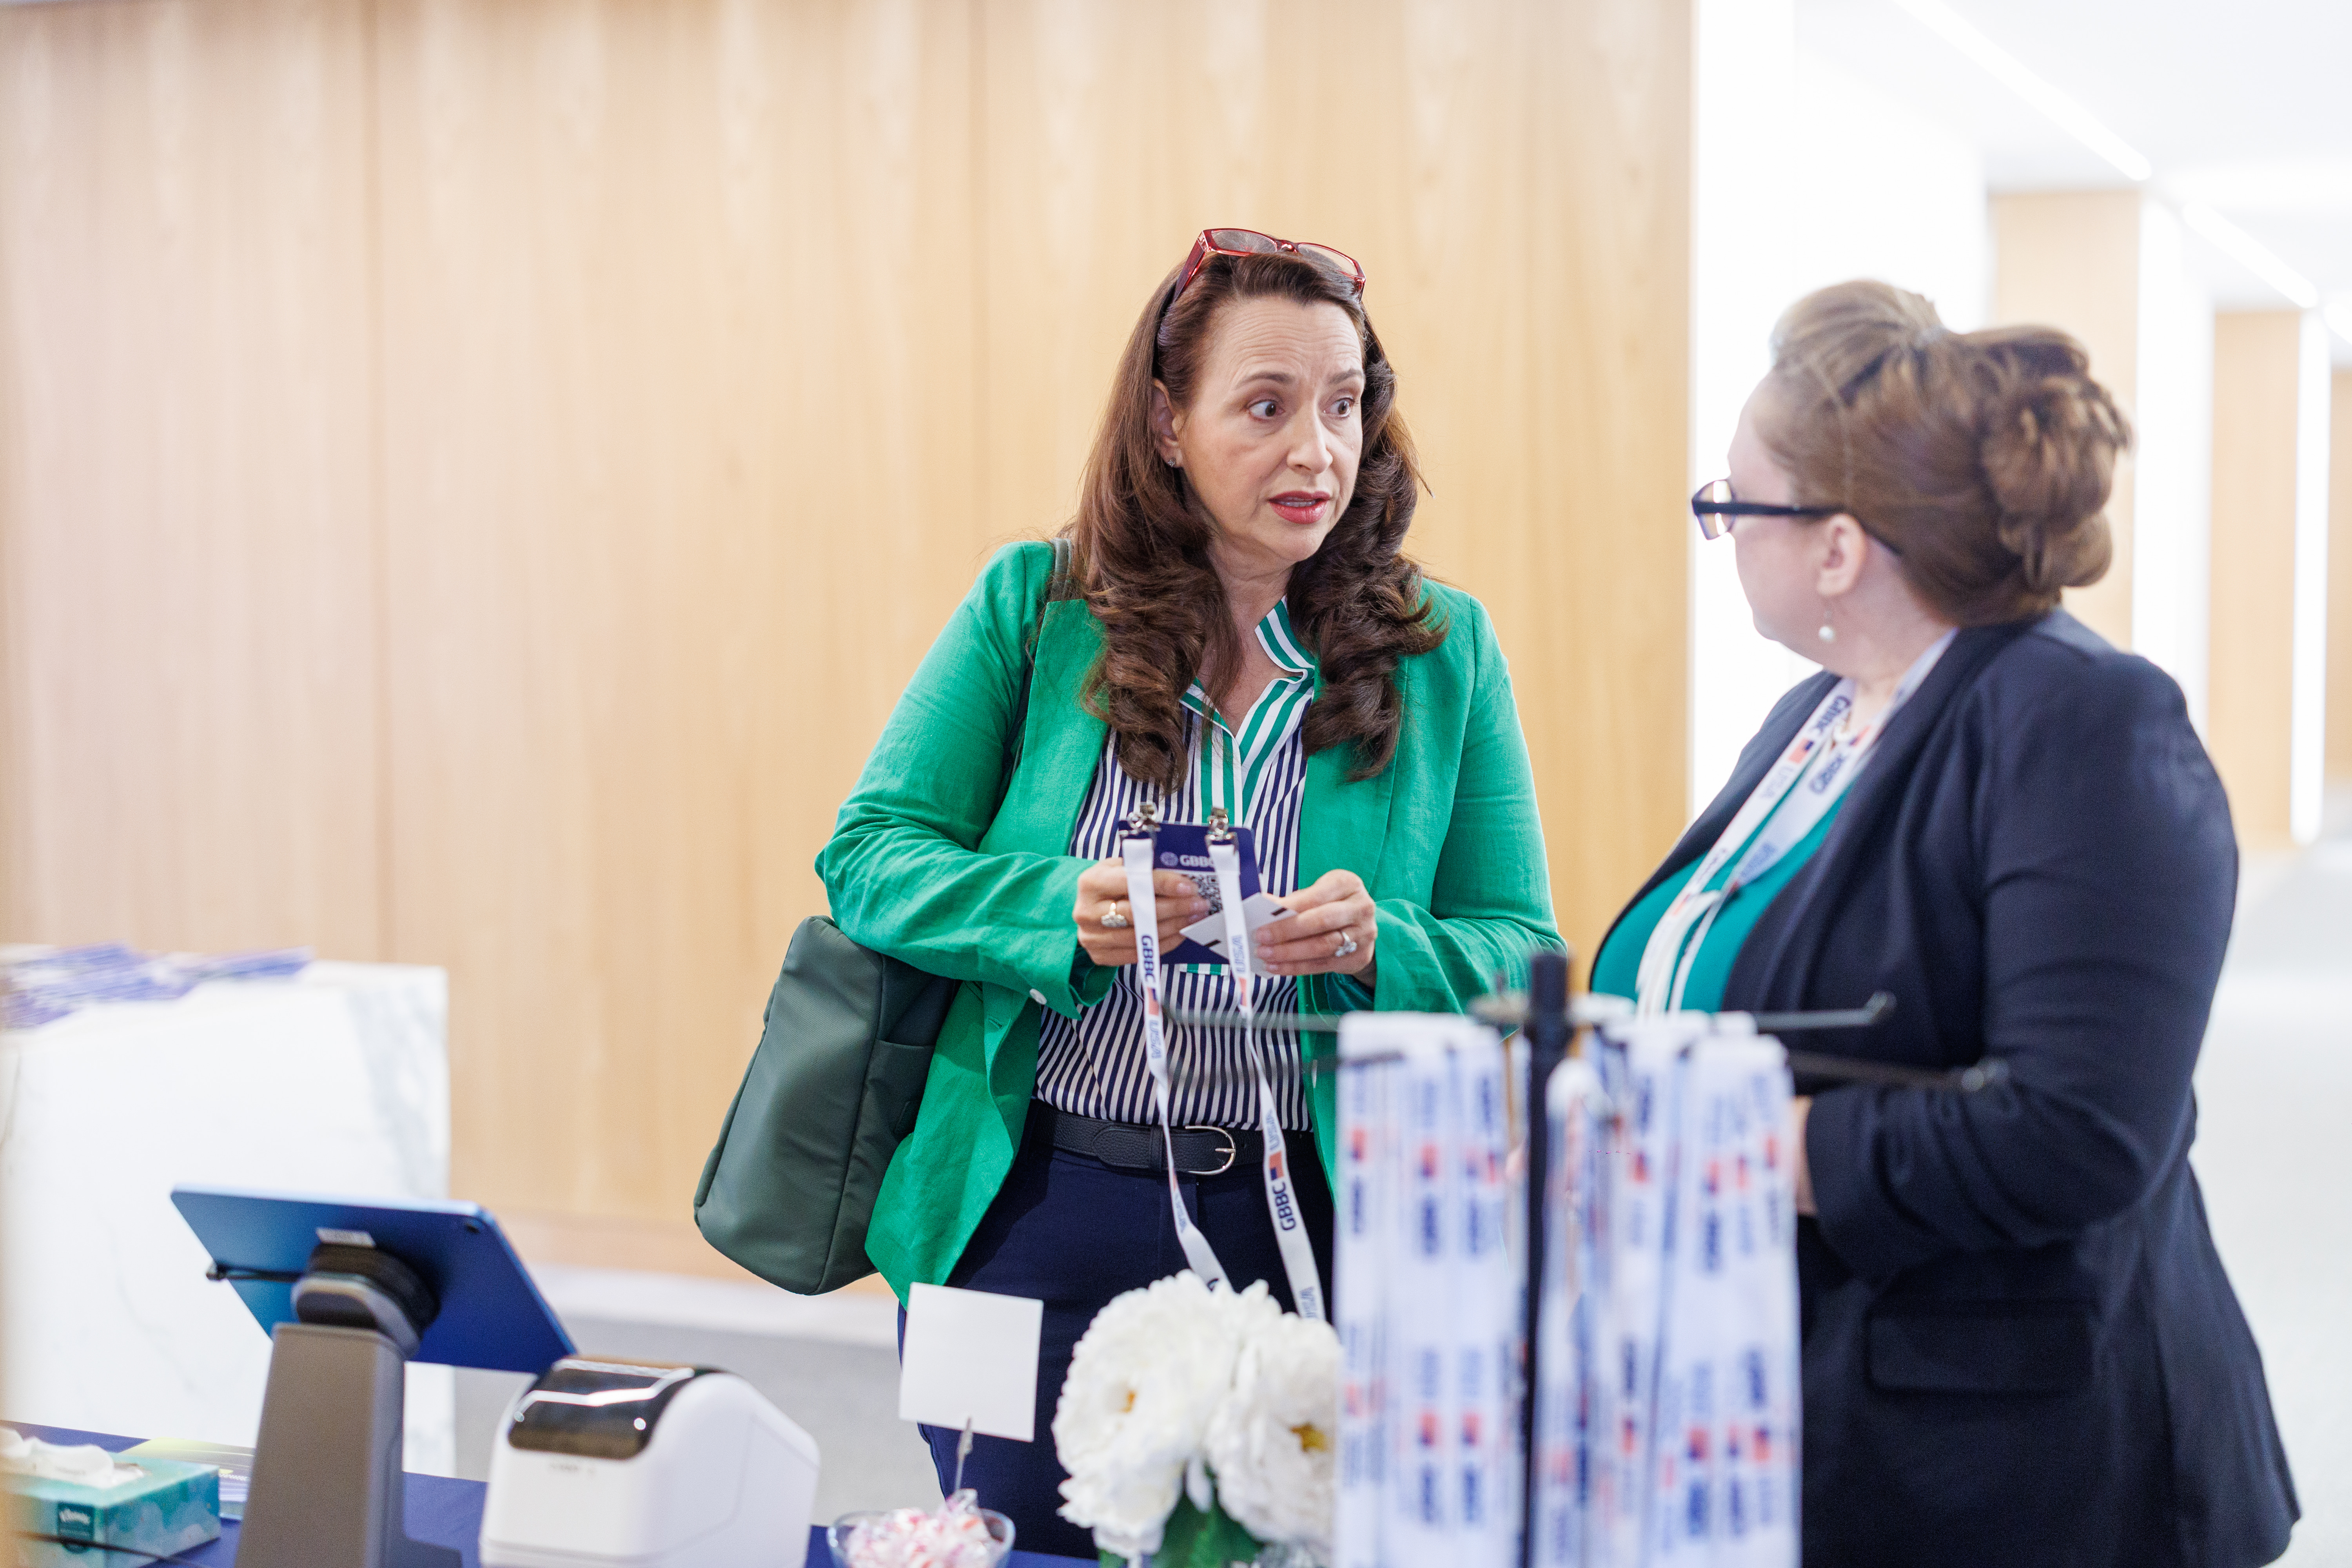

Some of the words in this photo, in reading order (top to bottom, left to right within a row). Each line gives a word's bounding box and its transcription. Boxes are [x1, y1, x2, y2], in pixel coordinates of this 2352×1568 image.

[1141, 935, 1156, 984] GBBC
[1231, 935, 1246, 973] USA
[1148, 1020, 1162, 1060] USA
[1271, 1181, 1296, 1231] GBBC
